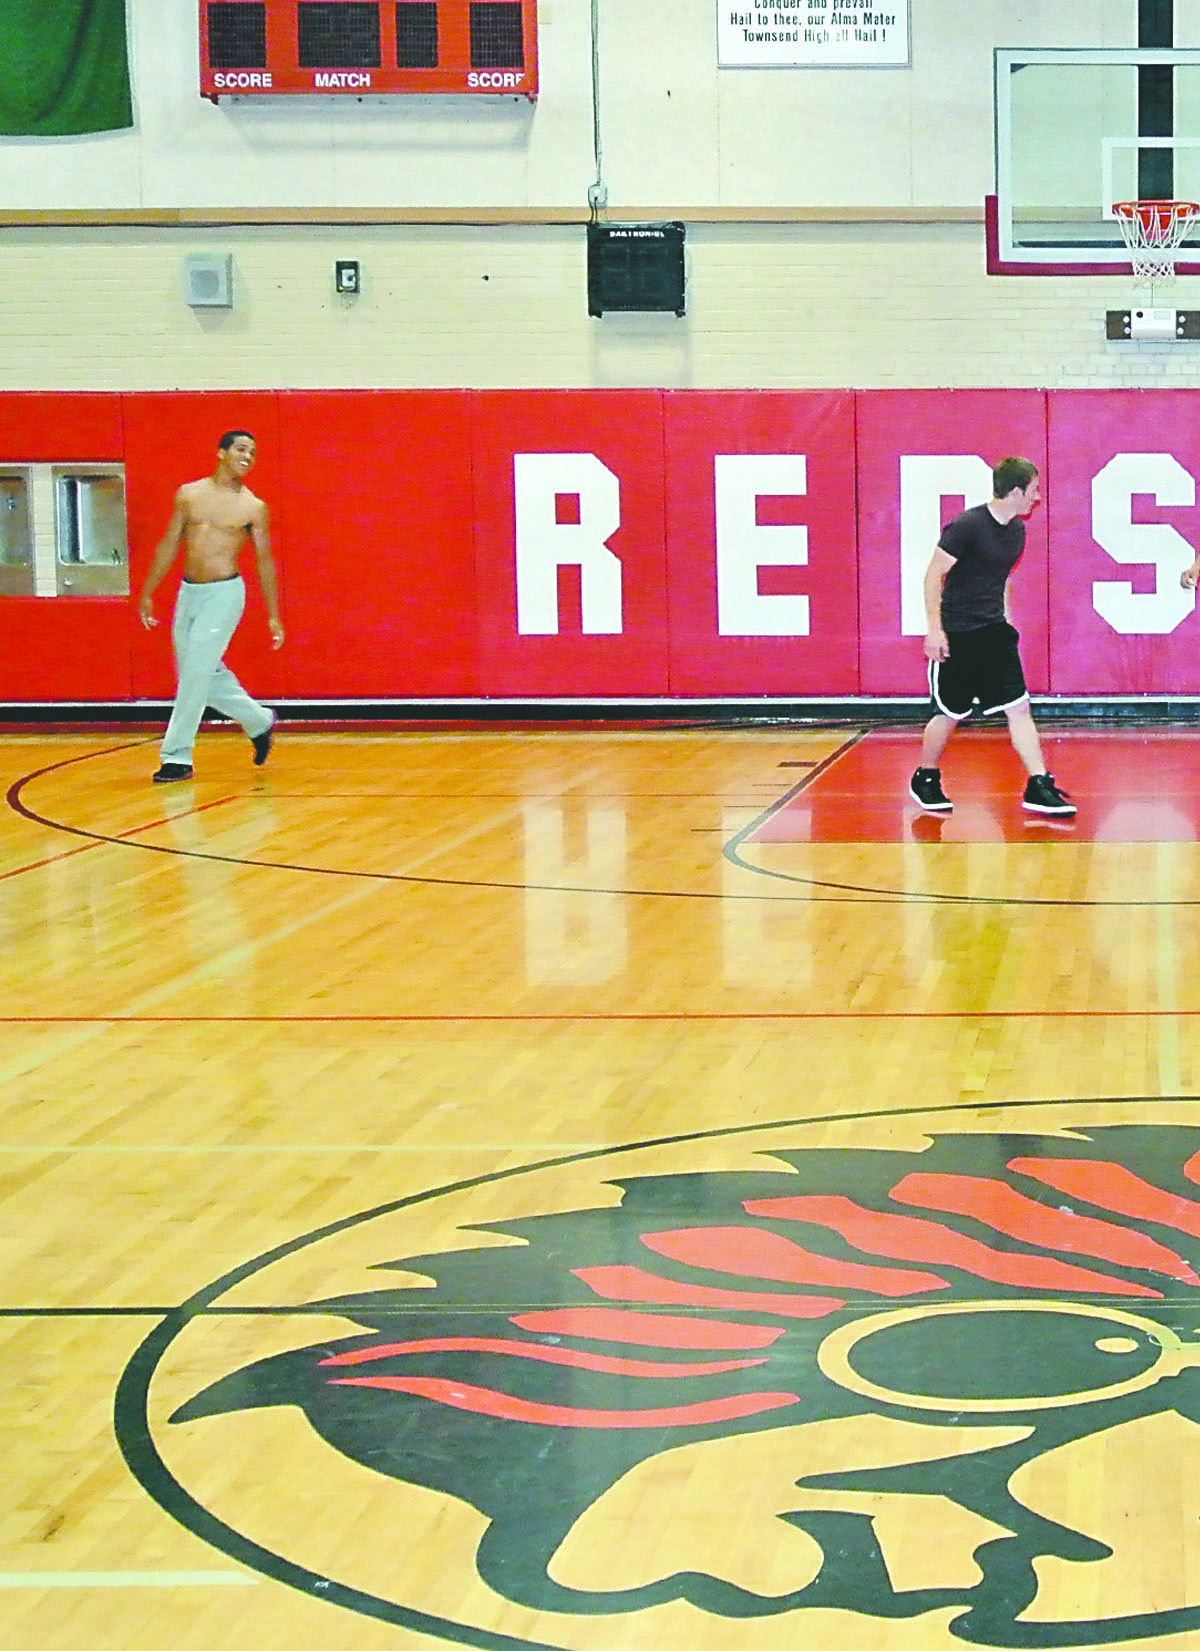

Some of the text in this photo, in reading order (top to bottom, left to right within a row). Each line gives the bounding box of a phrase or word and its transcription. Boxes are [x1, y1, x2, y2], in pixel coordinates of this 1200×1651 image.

[754, 0, 873, 10] Conquer and prevail
[730, 12, 896, 26] Hail to thee, our Alma Mater
[742, 28, 799, 42] Townsend
[804, 29, 829, 44] High
[854, 29, 877, 42] Hail
[214, 73, 272, 88] SCORE
[315, 73, 371, 87] MATCH
